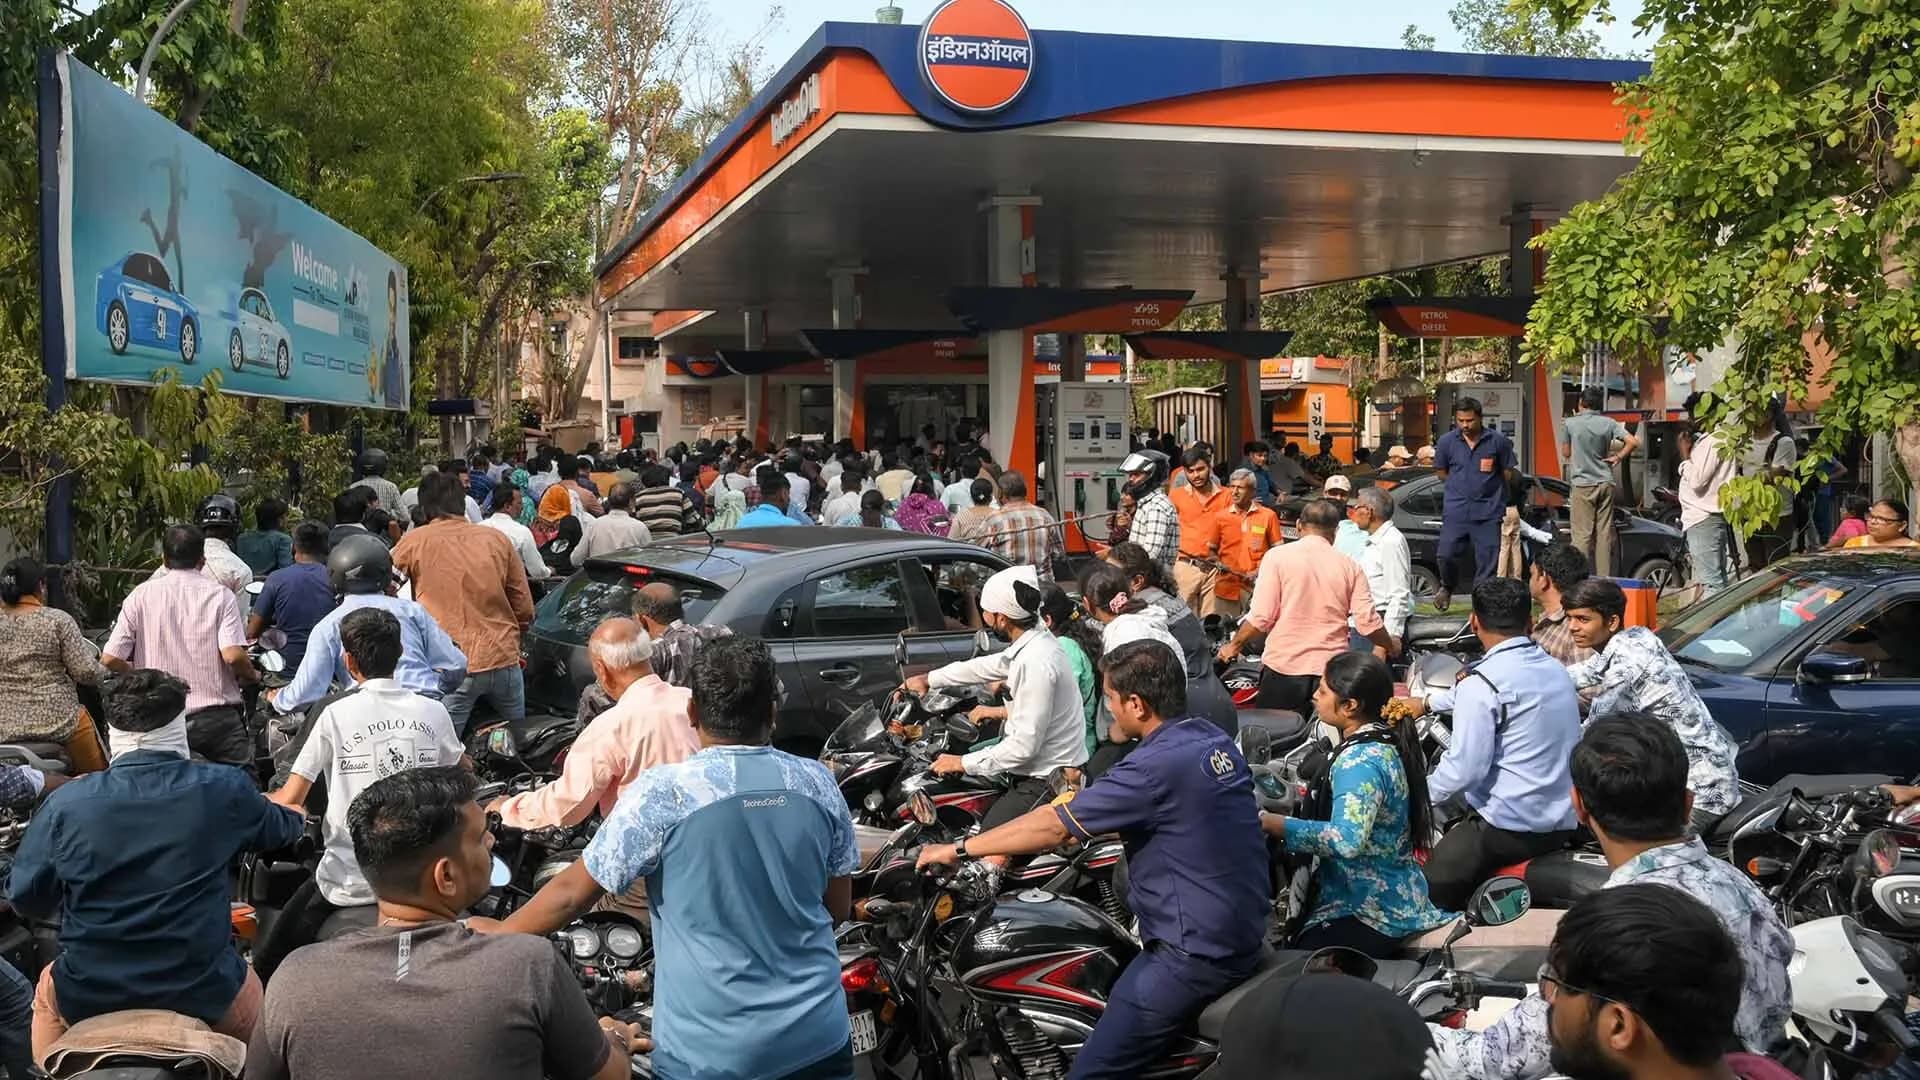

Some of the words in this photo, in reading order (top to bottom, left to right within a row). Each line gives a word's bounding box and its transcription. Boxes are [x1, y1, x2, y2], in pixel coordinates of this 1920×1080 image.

[927, 36, 1028, 64] इंडियनऑयल
[771, 73, 820, 147] IndianOil
[291, 240, 338, 292] Welcome
[1420, 311, 1449, 320] PETROL
[1131, 318, 1161, 328] PETROL
[1421, 323, 1448, 332] DIESEL
[368, 719, 405, 736] POLO
[340, 759, 369, 771] Classic
